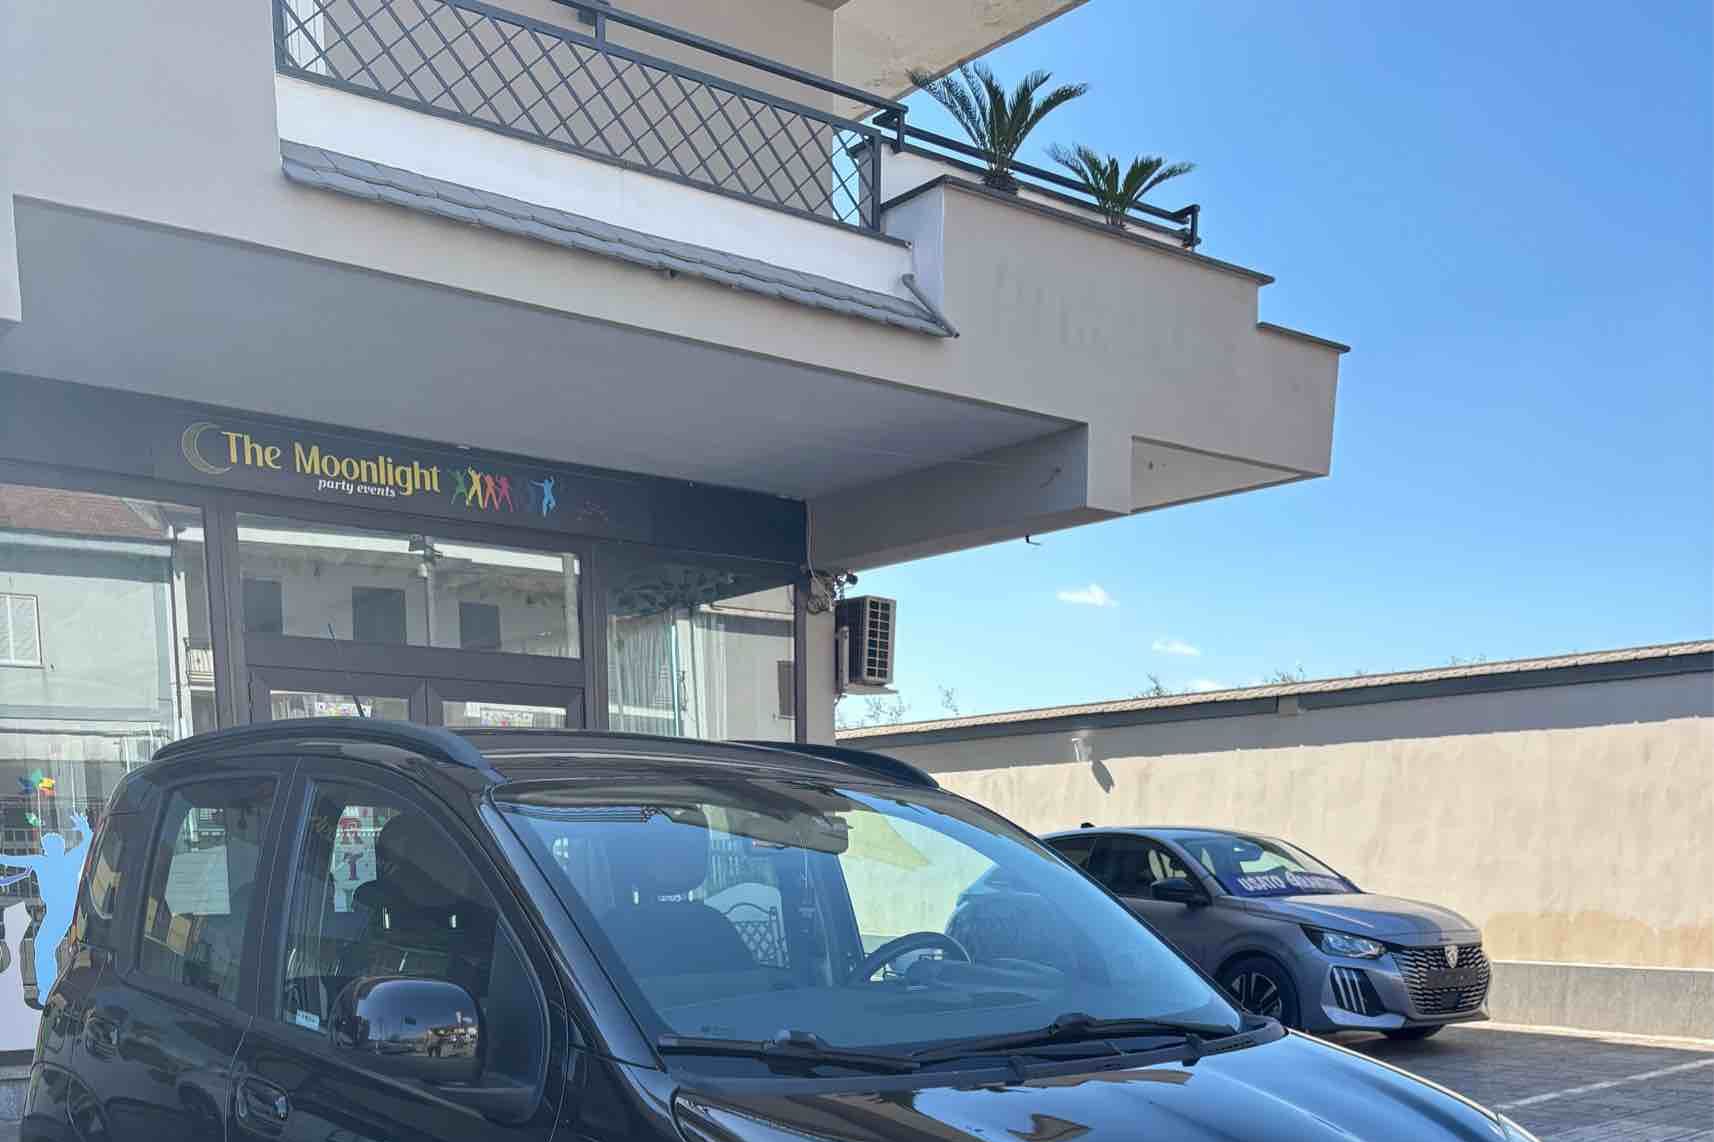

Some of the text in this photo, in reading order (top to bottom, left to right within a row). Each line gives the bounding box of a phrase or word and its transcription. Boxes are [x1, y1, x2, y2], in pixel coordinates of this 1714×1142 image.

[220, 431, 442, 496] The Moonlight
[318, 478, 396, 498] party events
[1238, 875, 1287, 891] USATO
